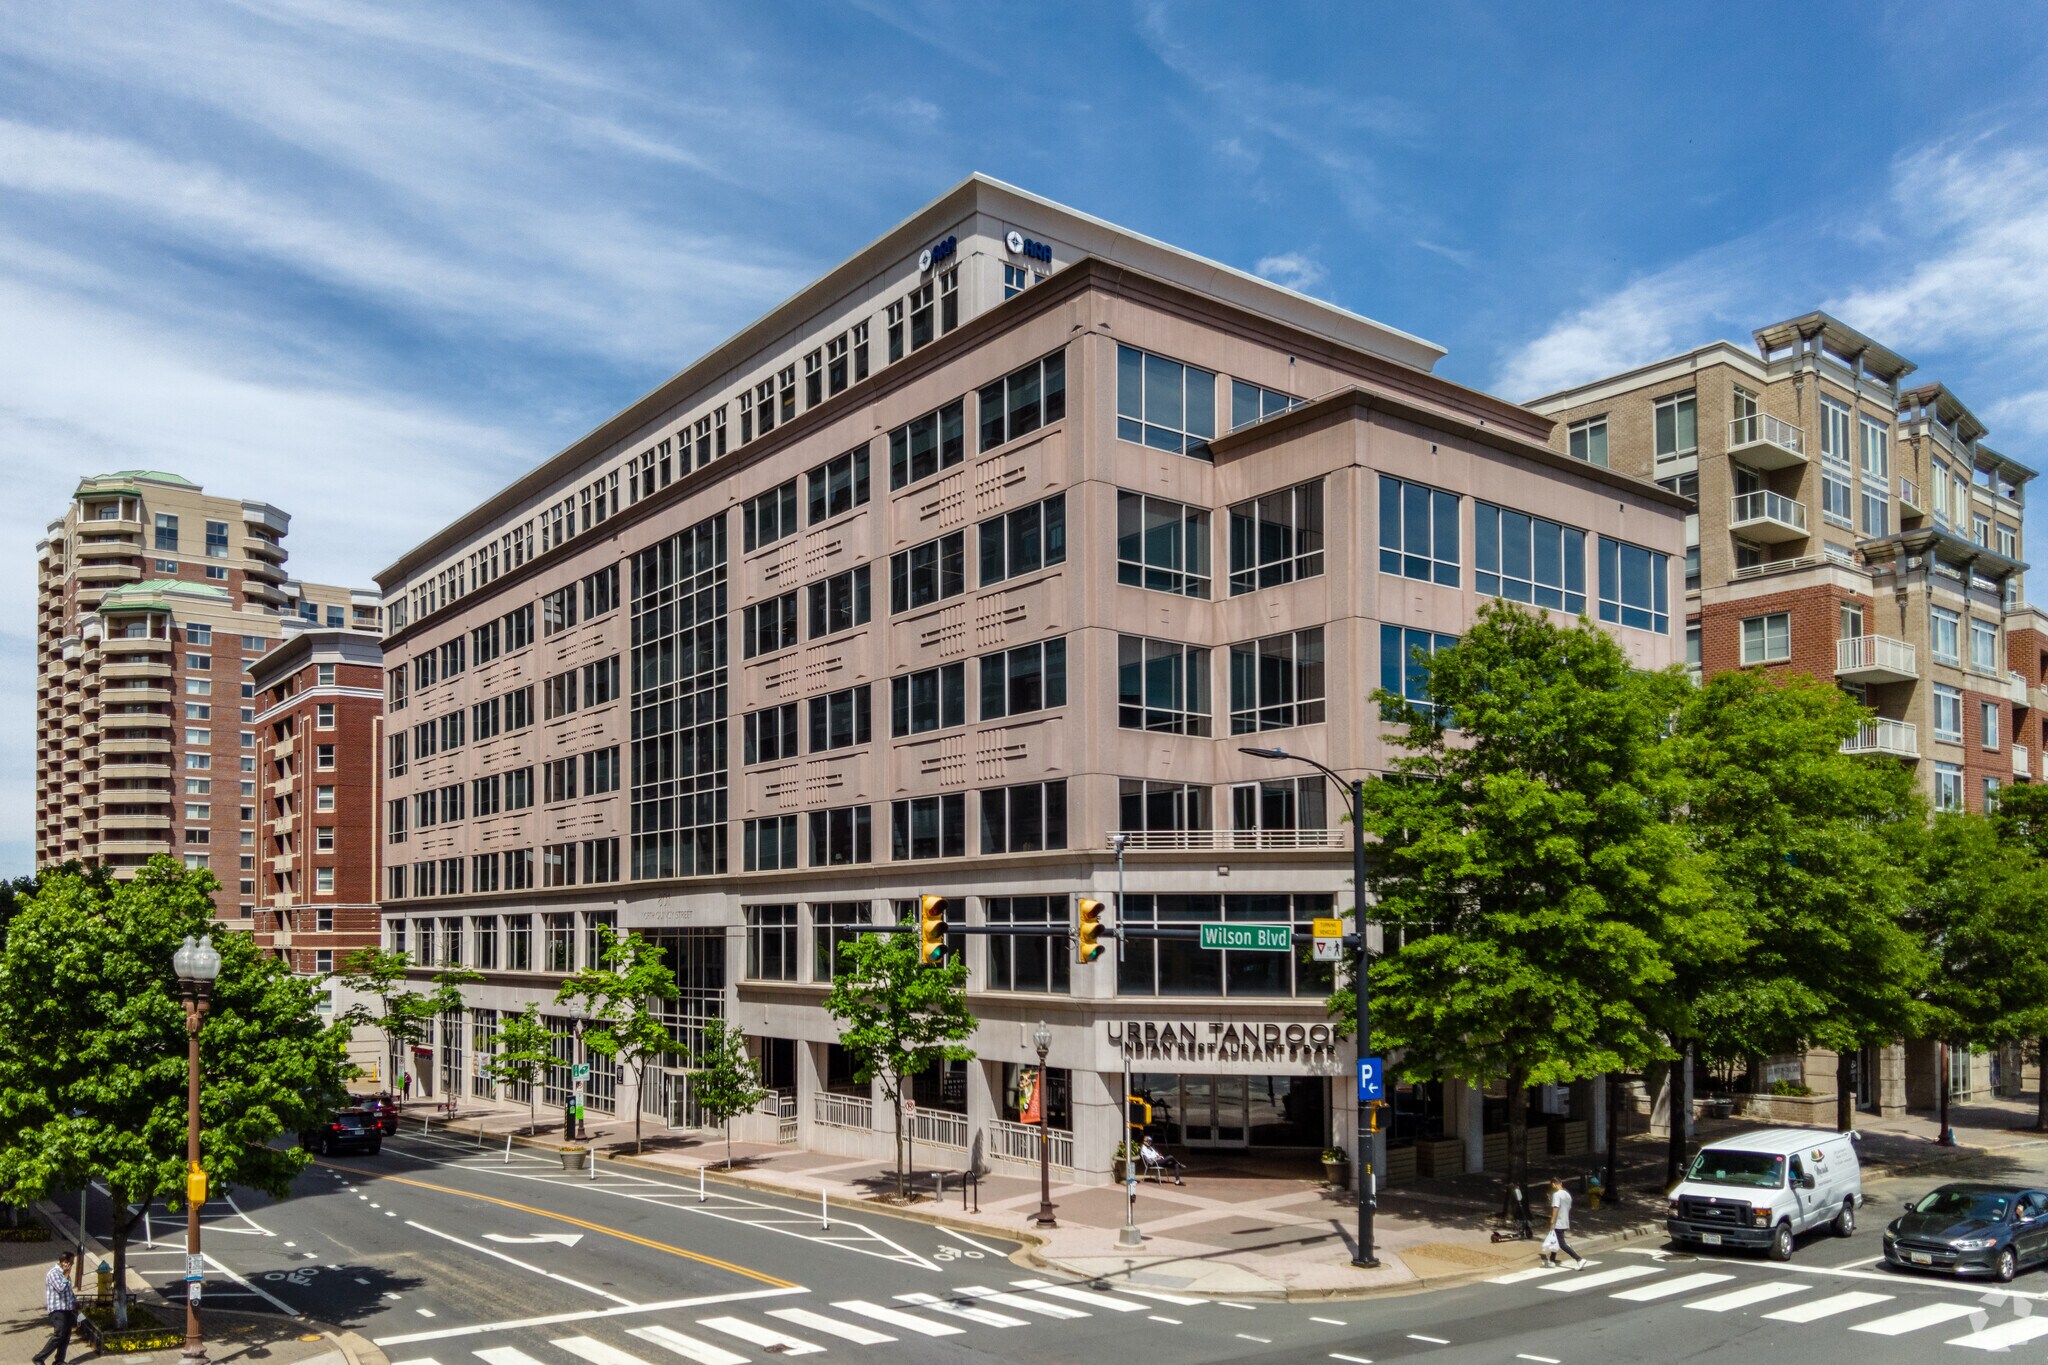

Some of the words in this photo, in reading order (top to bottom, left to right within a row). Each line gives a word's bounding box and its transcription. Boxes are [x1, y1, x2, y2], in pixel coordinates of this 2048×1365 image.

[1205, 927, 1252, 945] Wilson
[1258, 929, 1287, 946] Blvd
[1107, 1021, 1196, 1042] URBAN
[1120, 1041, 1173, 1056] INDIAN
[1177, 1042, 1285, 1057] RESTAURANT
[1304, 1044, 1336, 1056] BAR
[1361, 1064, 1373, 1088] P
